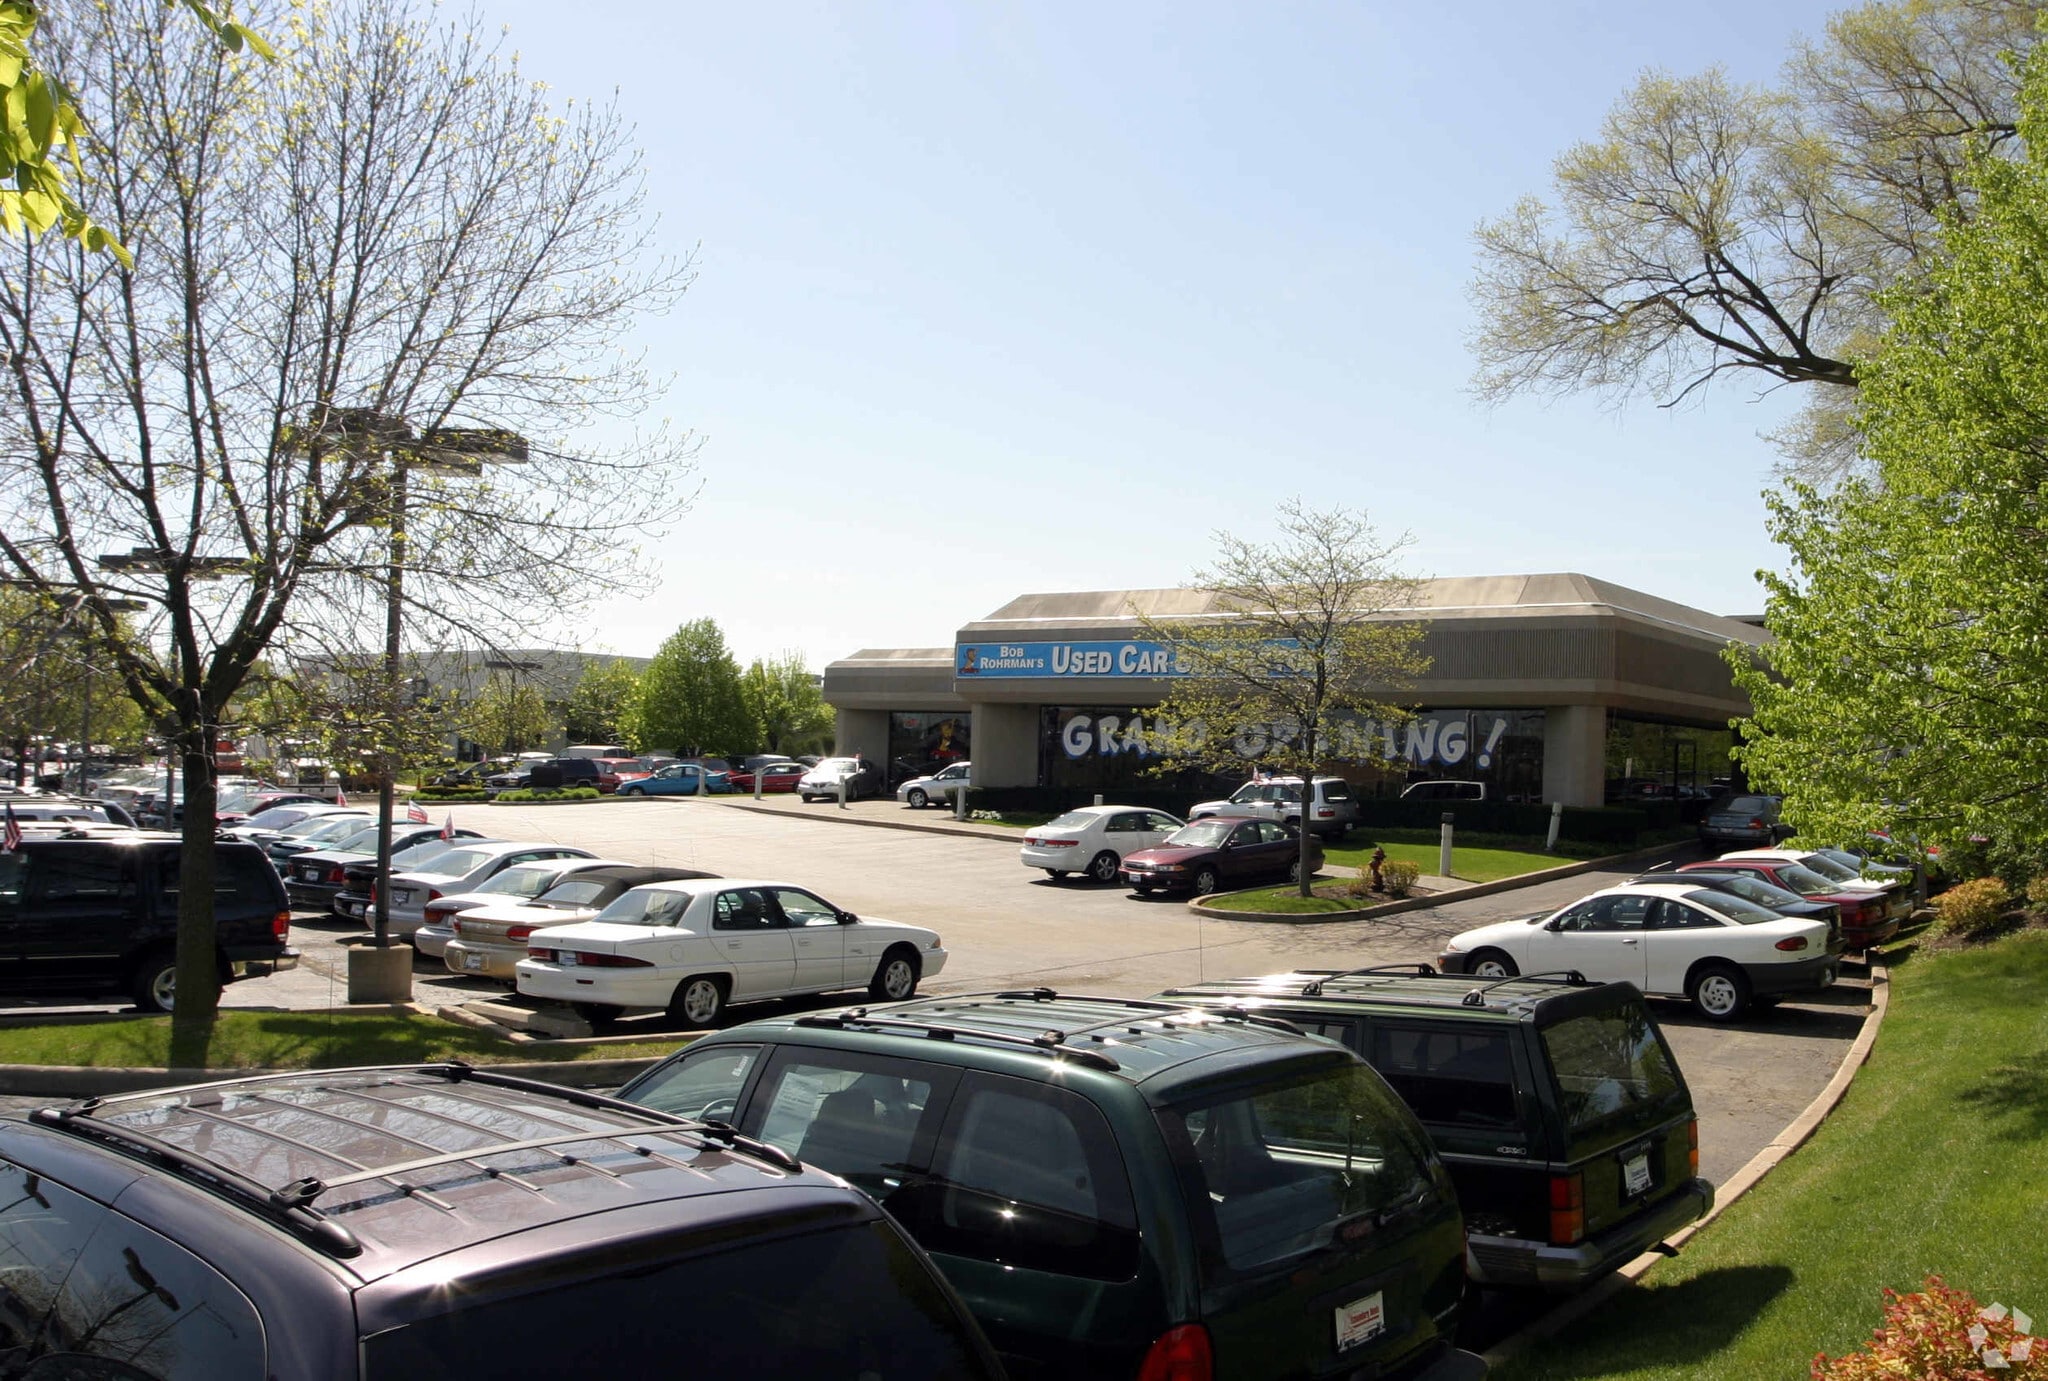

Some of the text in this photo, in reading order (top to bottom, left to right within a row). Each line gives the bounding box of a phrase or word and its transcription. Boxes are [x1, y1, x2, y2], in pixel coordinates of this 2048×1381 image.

[999, 645, 1024, 658] BOB
[979, 656, 1045, 670] ROHRMAN'S
[1051, 645, 1113, 675] USED
[1118, 644, 1168, 674] CAR
